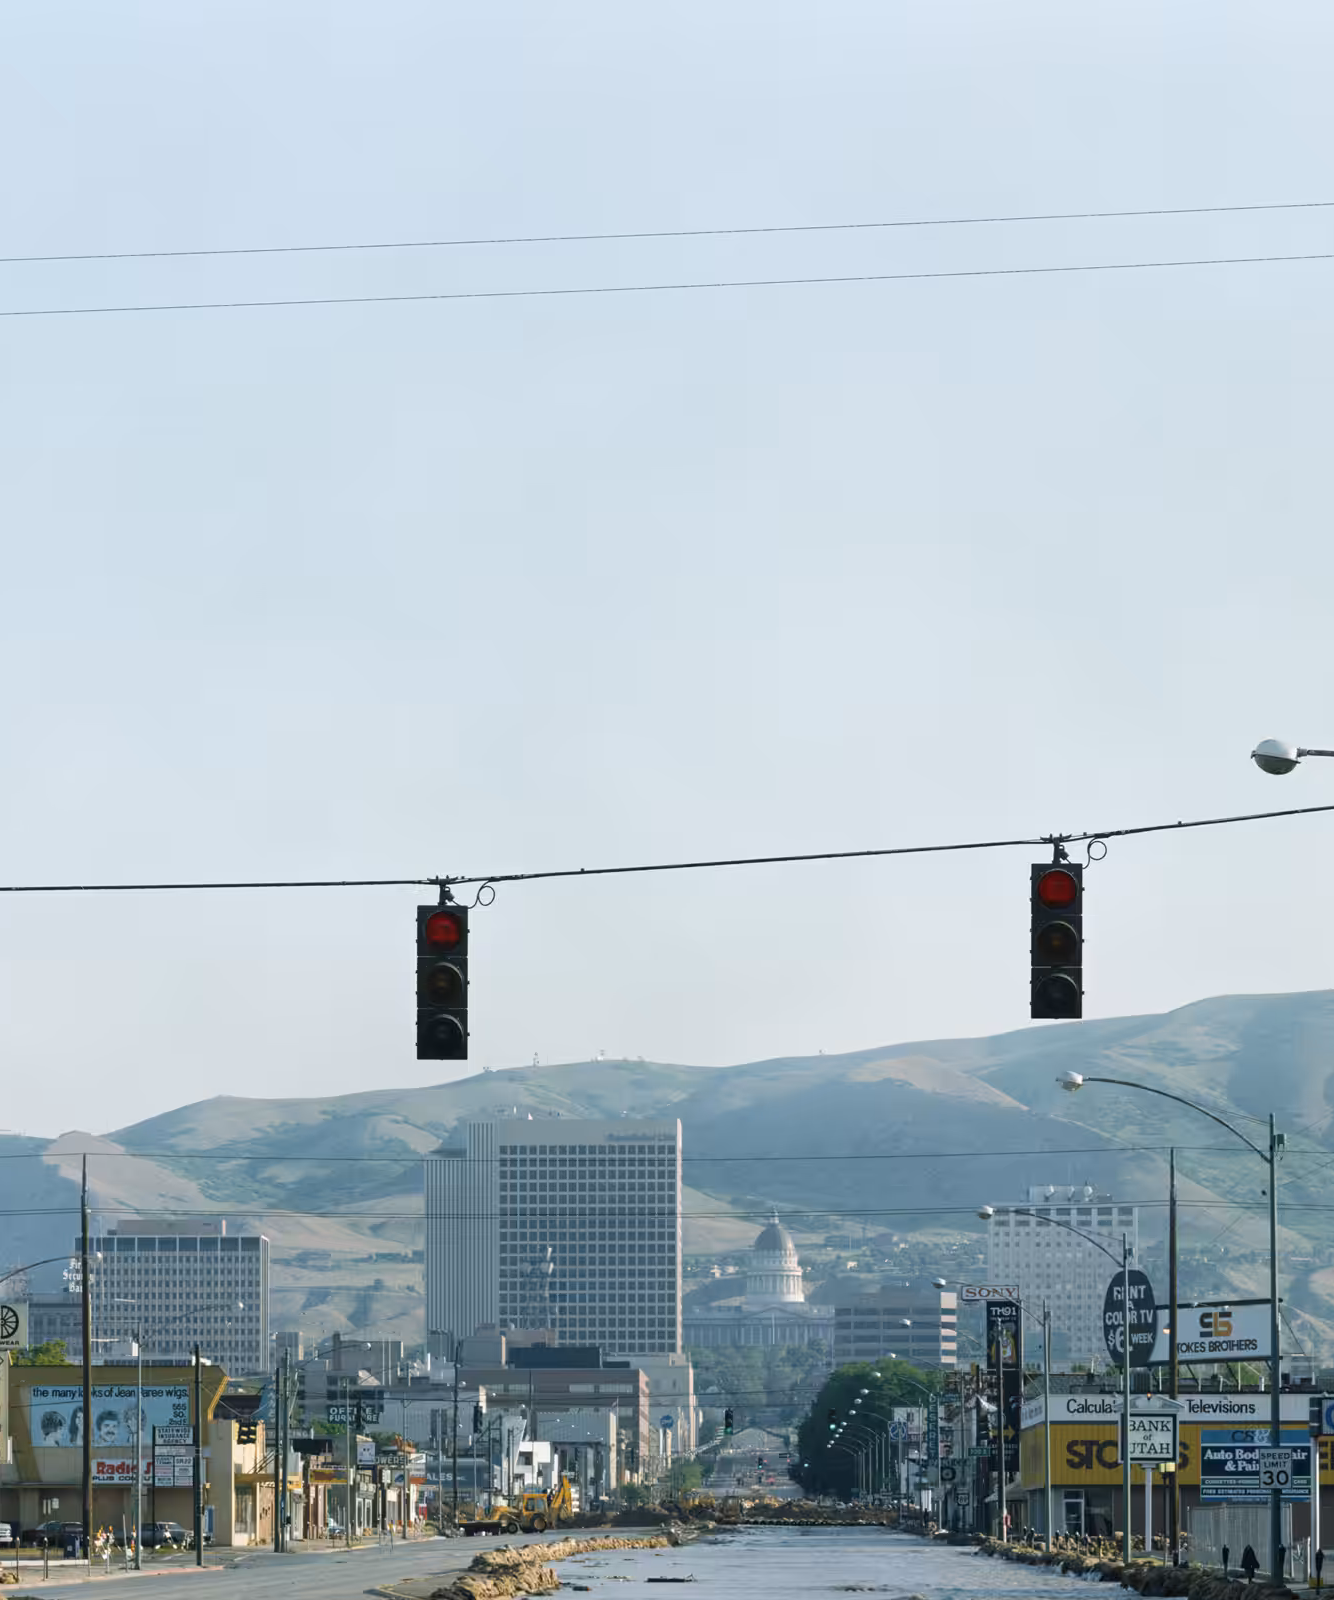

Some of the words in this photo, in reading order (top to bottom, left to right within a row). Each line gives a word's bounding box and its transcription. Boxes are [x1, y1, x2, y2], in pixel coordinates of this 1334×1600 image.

[966, 1288, 1016, 1298] SONY
[1113, 1285, 1146, 1300] RNT
[1105, 1310, 1138, 1325] COLR
[1140, 1309, 1153, 1323] TV
[1131, 1333, 1153, 1344] WEEK
[1177, 1342, 1206, 1353] TOKES
[1208, 1339, 1257, 1352] BROTHERS
[33, 1388, 49, 1397] the
[52, 1389, 75, 1399] many
[78, 1388, 103, 1397] loks
[104, 1388, 114, 1397] of
[115, 1388, 135, 1398] Jean
[329, 1407, 373, 1415] OFFIE
[1187, 1399, 1256, 1414] Televisions
[1204, 1448, 1233, 1460] Auto
[1235, 1448, 1259, 1460] Bod
[427, 1473, 453, 1481] ALES
[1263, 1471, 1289, 1485] 30
